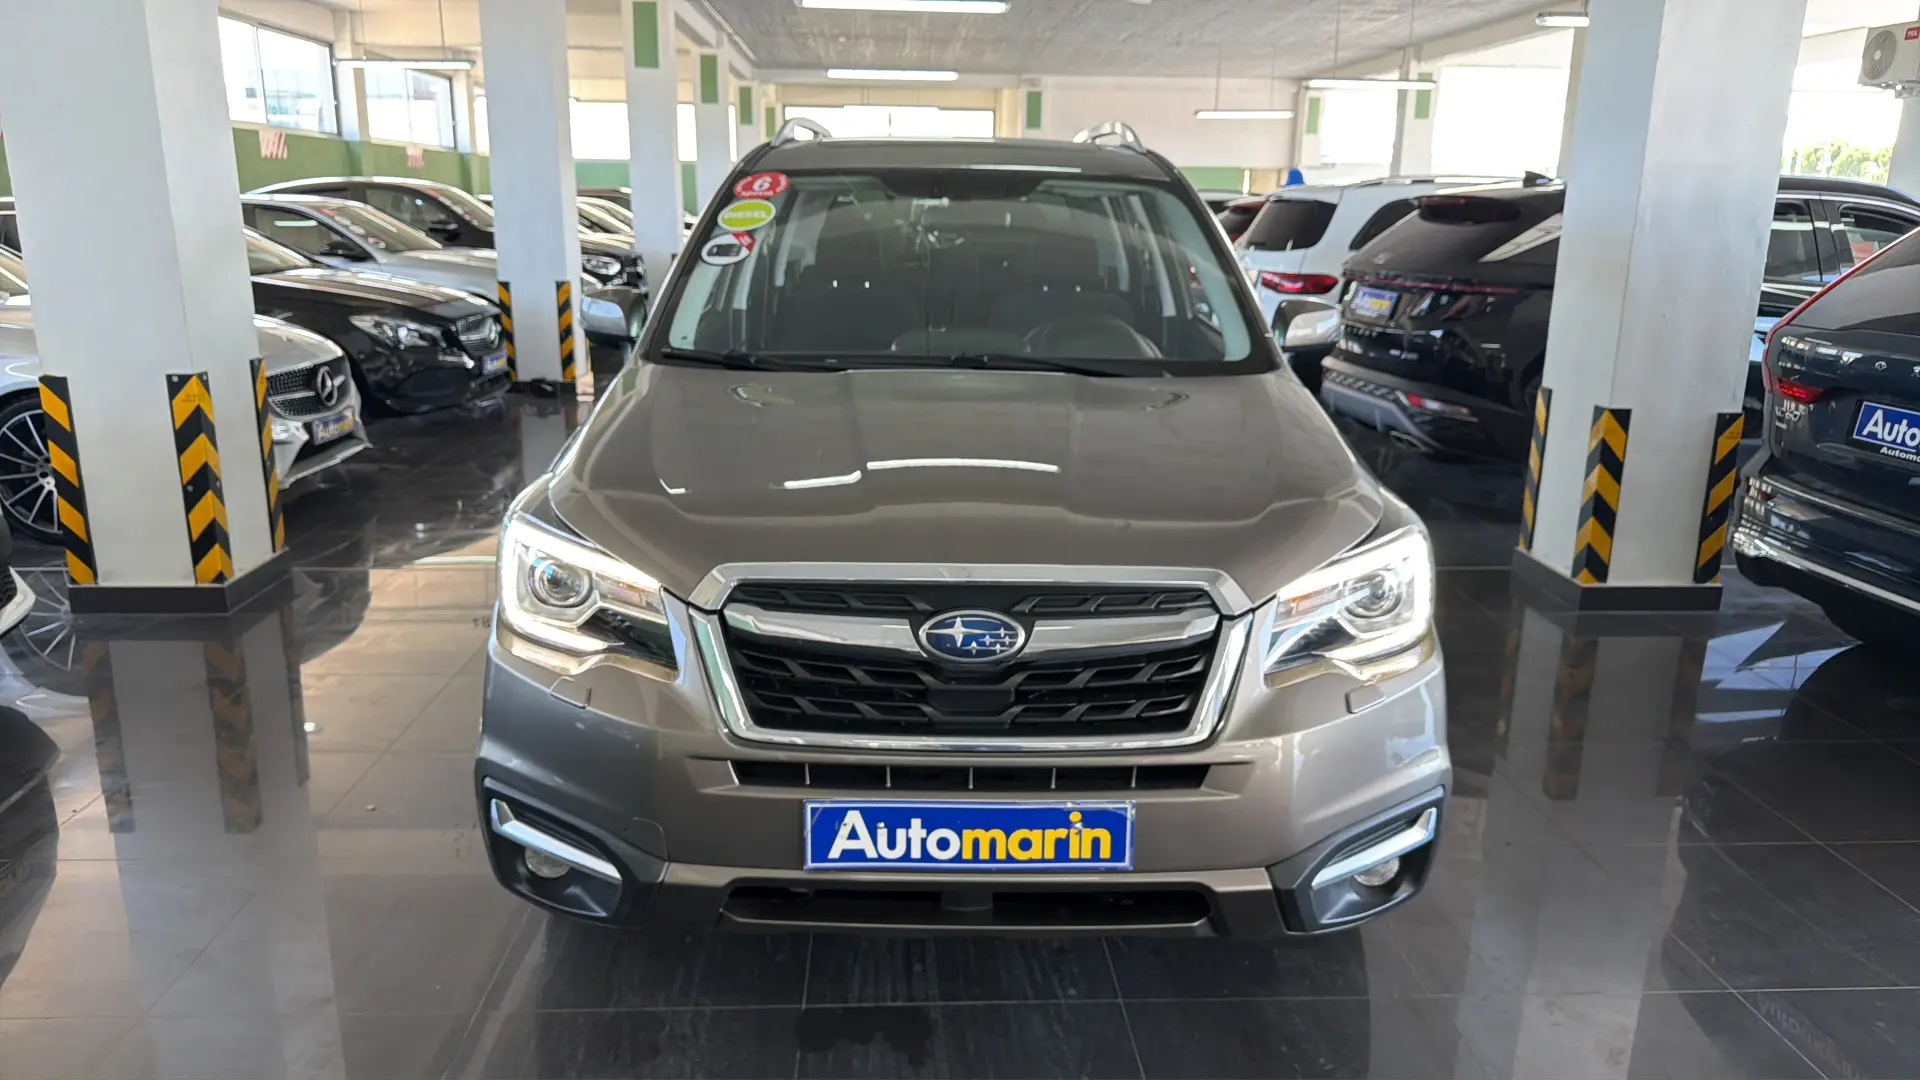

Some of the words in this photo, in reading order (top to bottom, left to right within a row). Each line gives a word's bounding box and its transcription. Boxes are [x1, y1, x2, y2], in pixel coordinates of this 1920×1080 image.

[752, 176, 773, 193] 6
[1862, 409, 1920, 448] Auto
[827, 810, 1112, 860] Automarin
